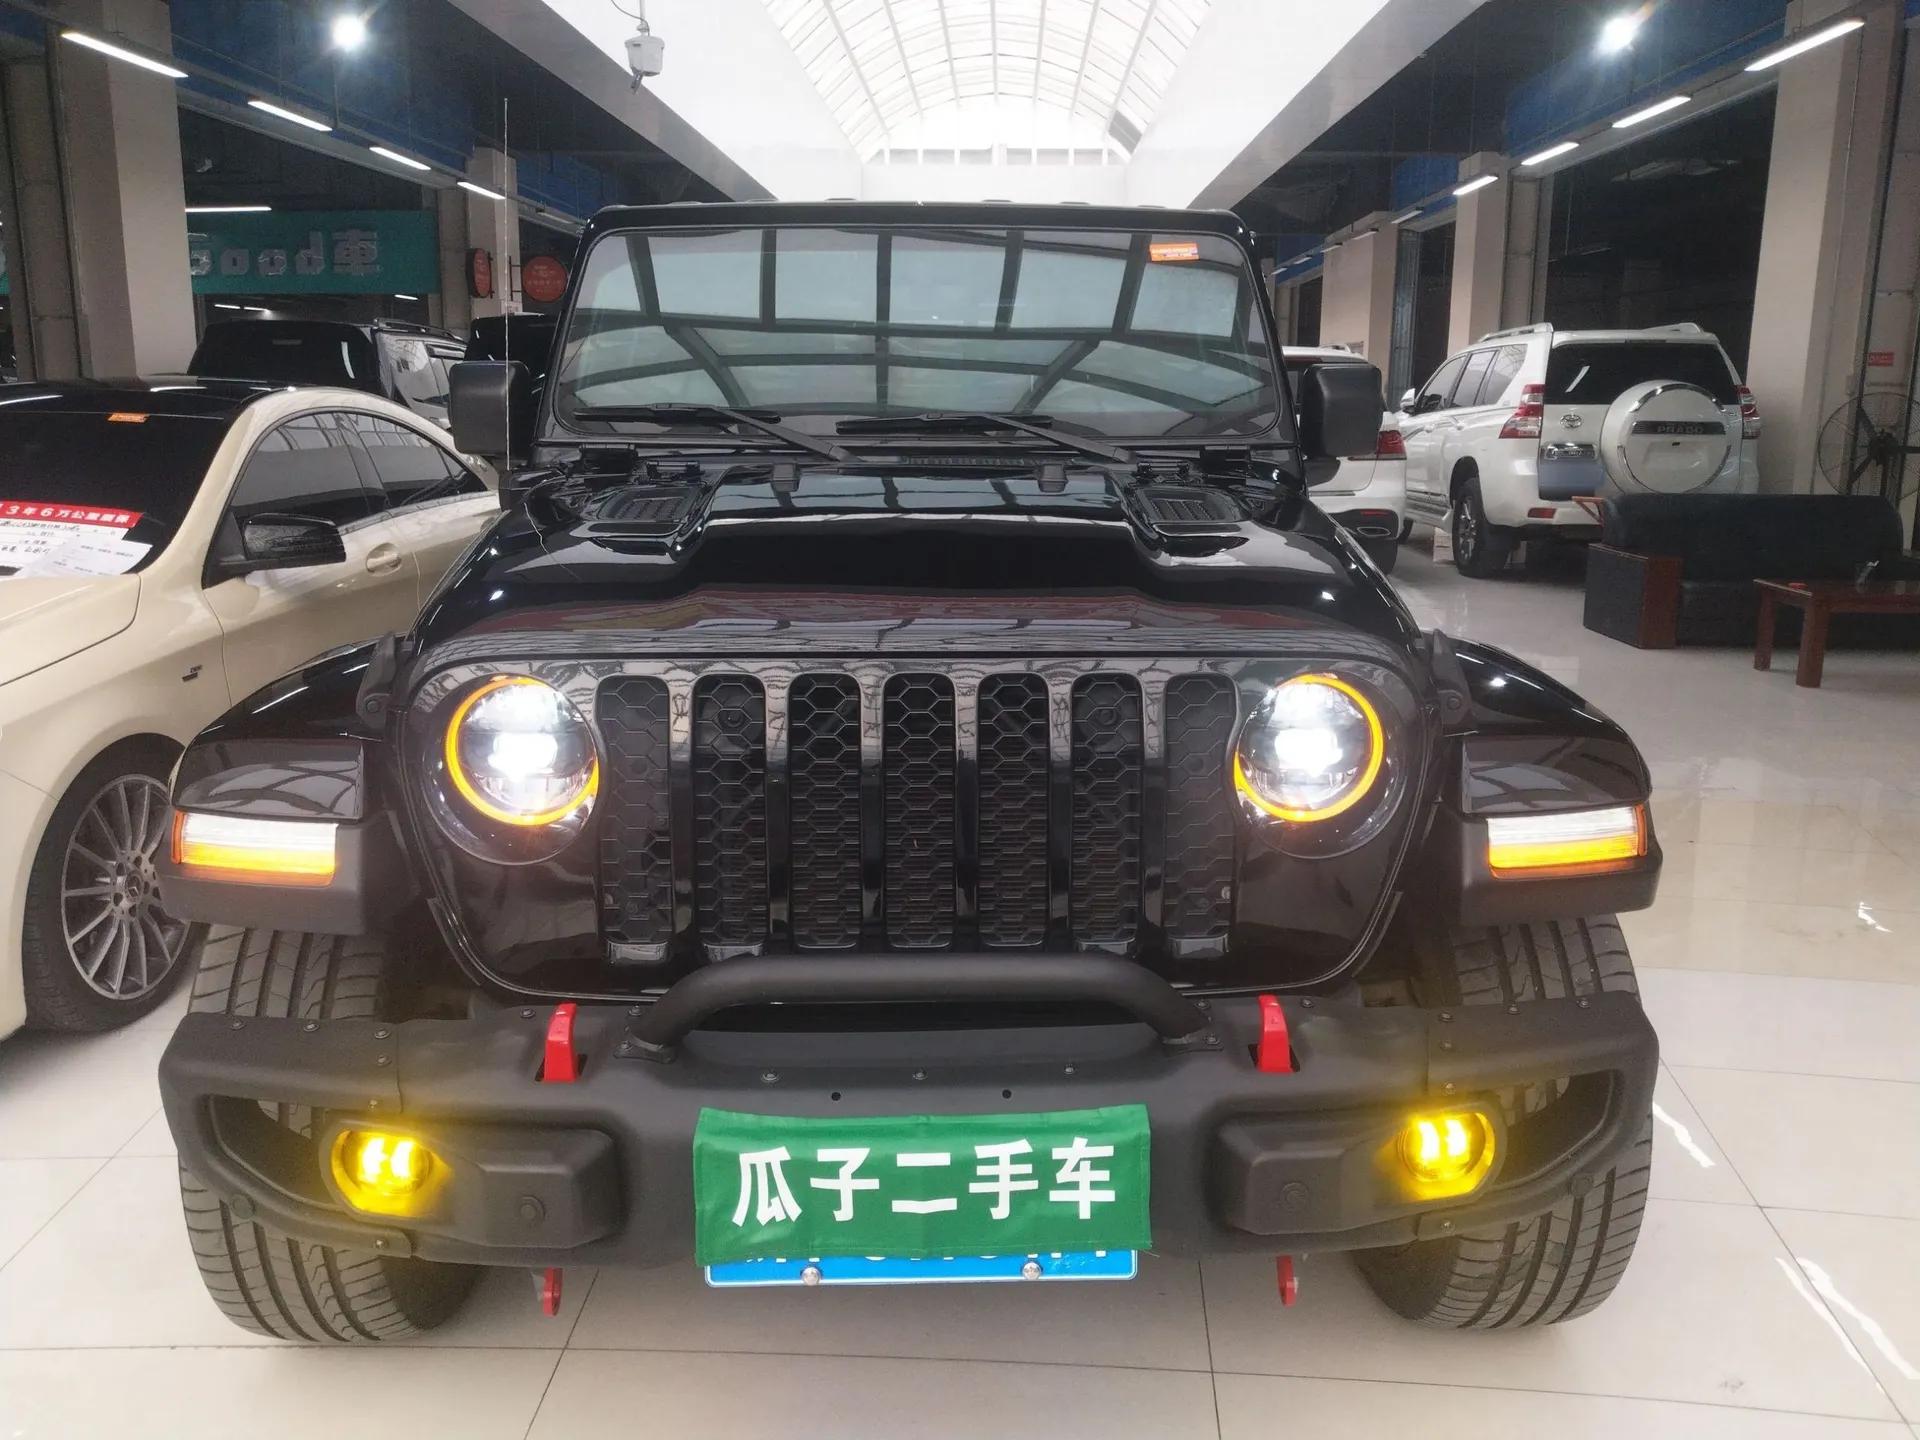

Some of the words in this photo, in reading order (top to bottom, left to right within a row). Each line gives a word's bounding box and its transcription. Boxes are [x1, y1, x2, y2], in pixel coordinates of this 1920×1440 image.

[732, 1137, 1117, 1228] 瓜子二手车
